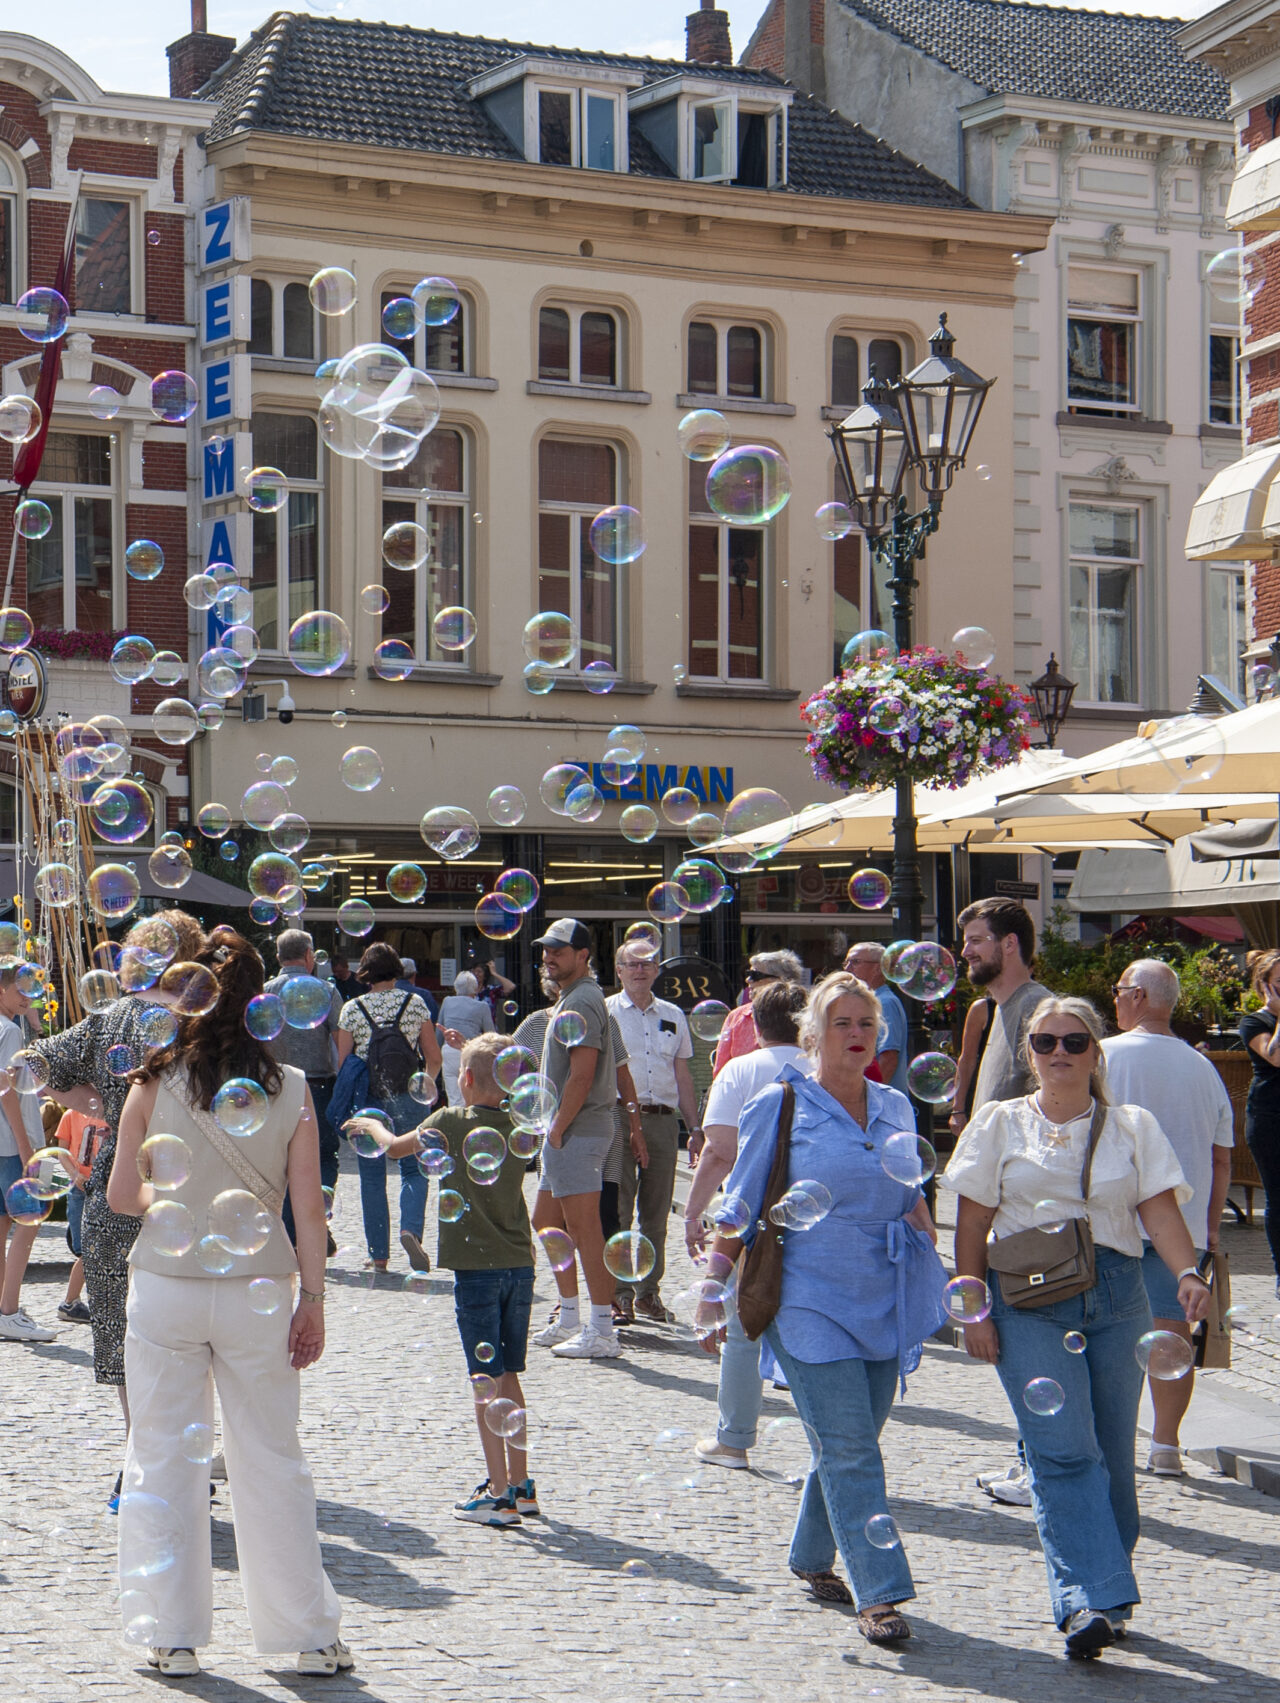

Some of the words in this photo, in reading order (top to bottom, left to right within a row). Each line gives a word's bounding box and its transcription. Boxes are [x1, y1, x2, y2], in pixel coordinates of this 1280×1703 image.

[204, 203, 236, 654] ZEEMAN
[561, 761, 734, 803] ZEEMAN
[664, 976, 711, 998] BAR
